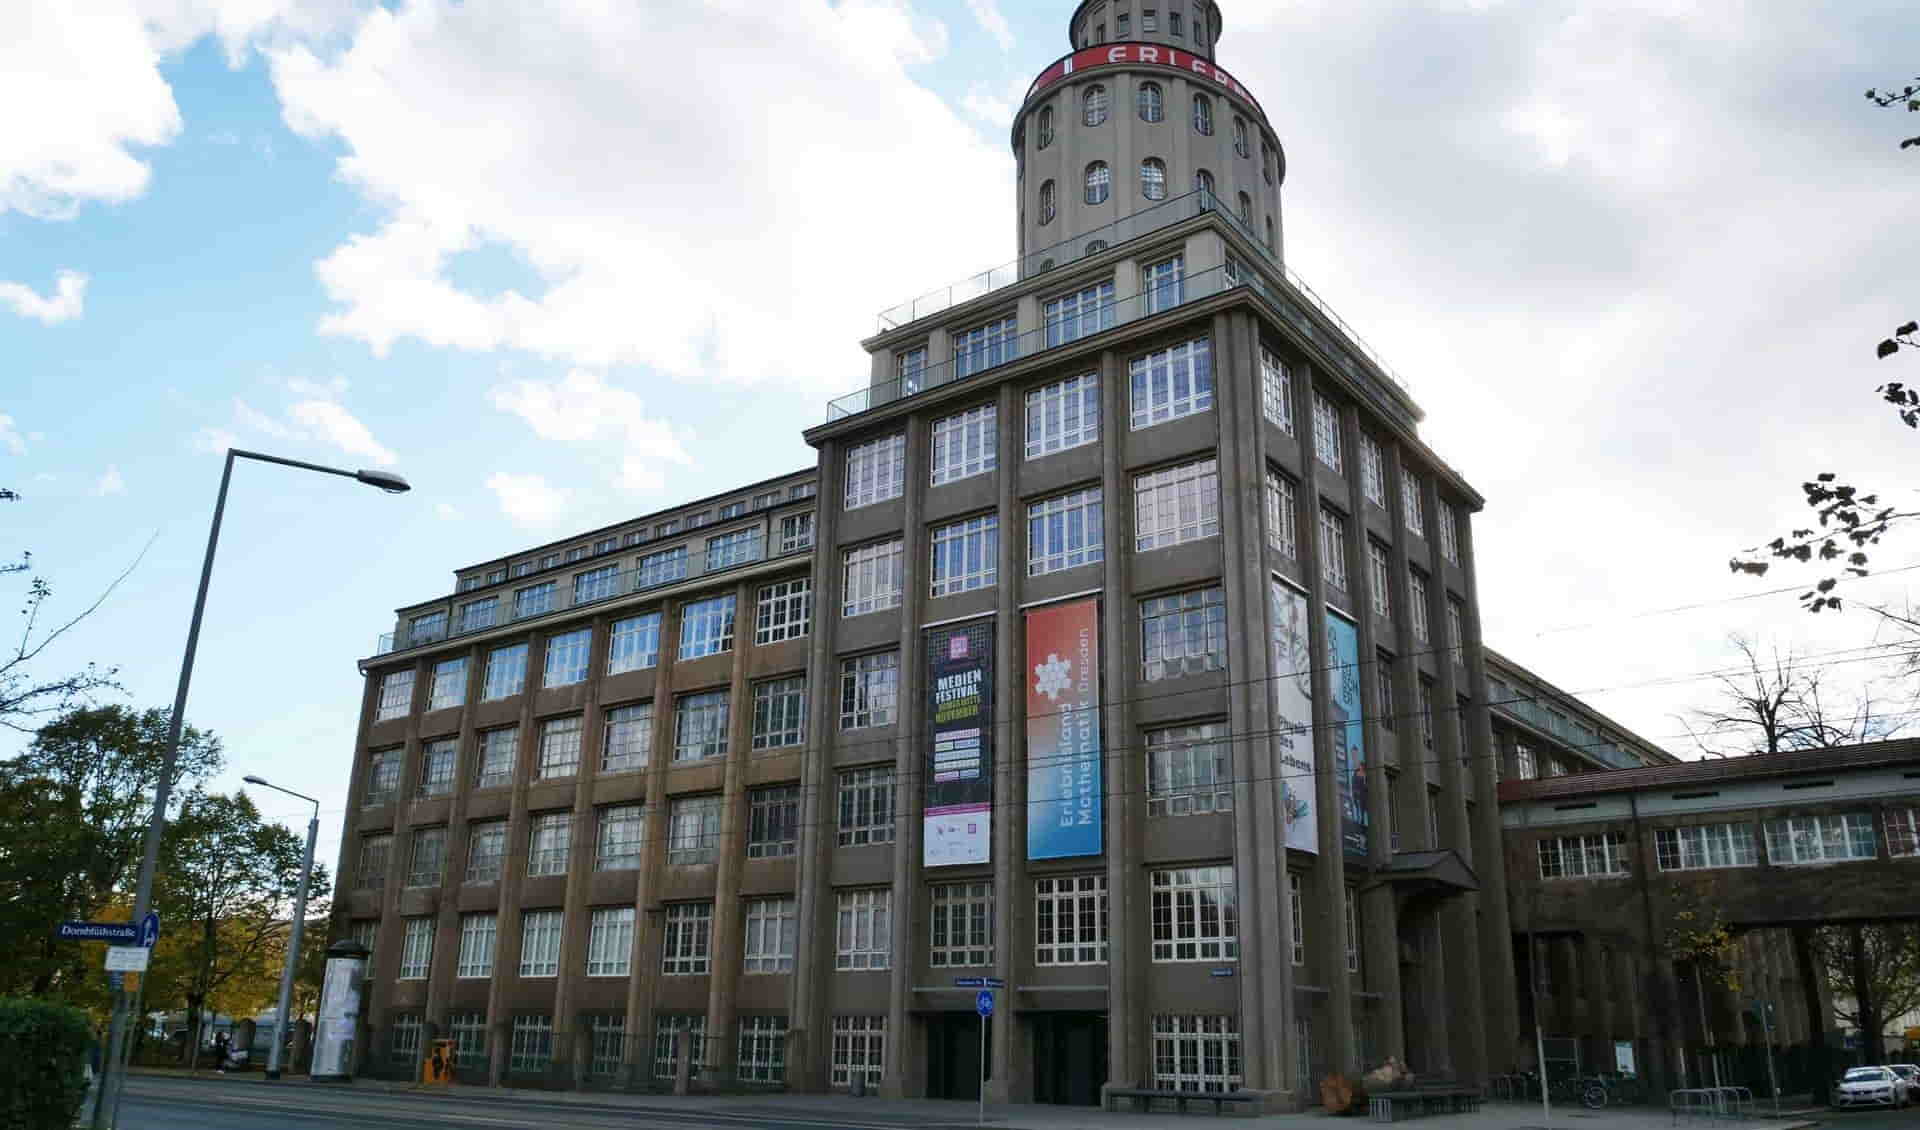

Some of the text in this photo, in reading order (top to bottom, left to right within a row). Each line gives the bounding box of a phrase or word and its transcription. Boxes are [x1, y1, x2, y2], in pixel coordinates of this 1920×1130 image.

[937, 668, 982, 691] MEDIEN
[935, 684, 980, 704] FESTIVAL
[1078, 628, 1093, 825] Mathematik Dresden
